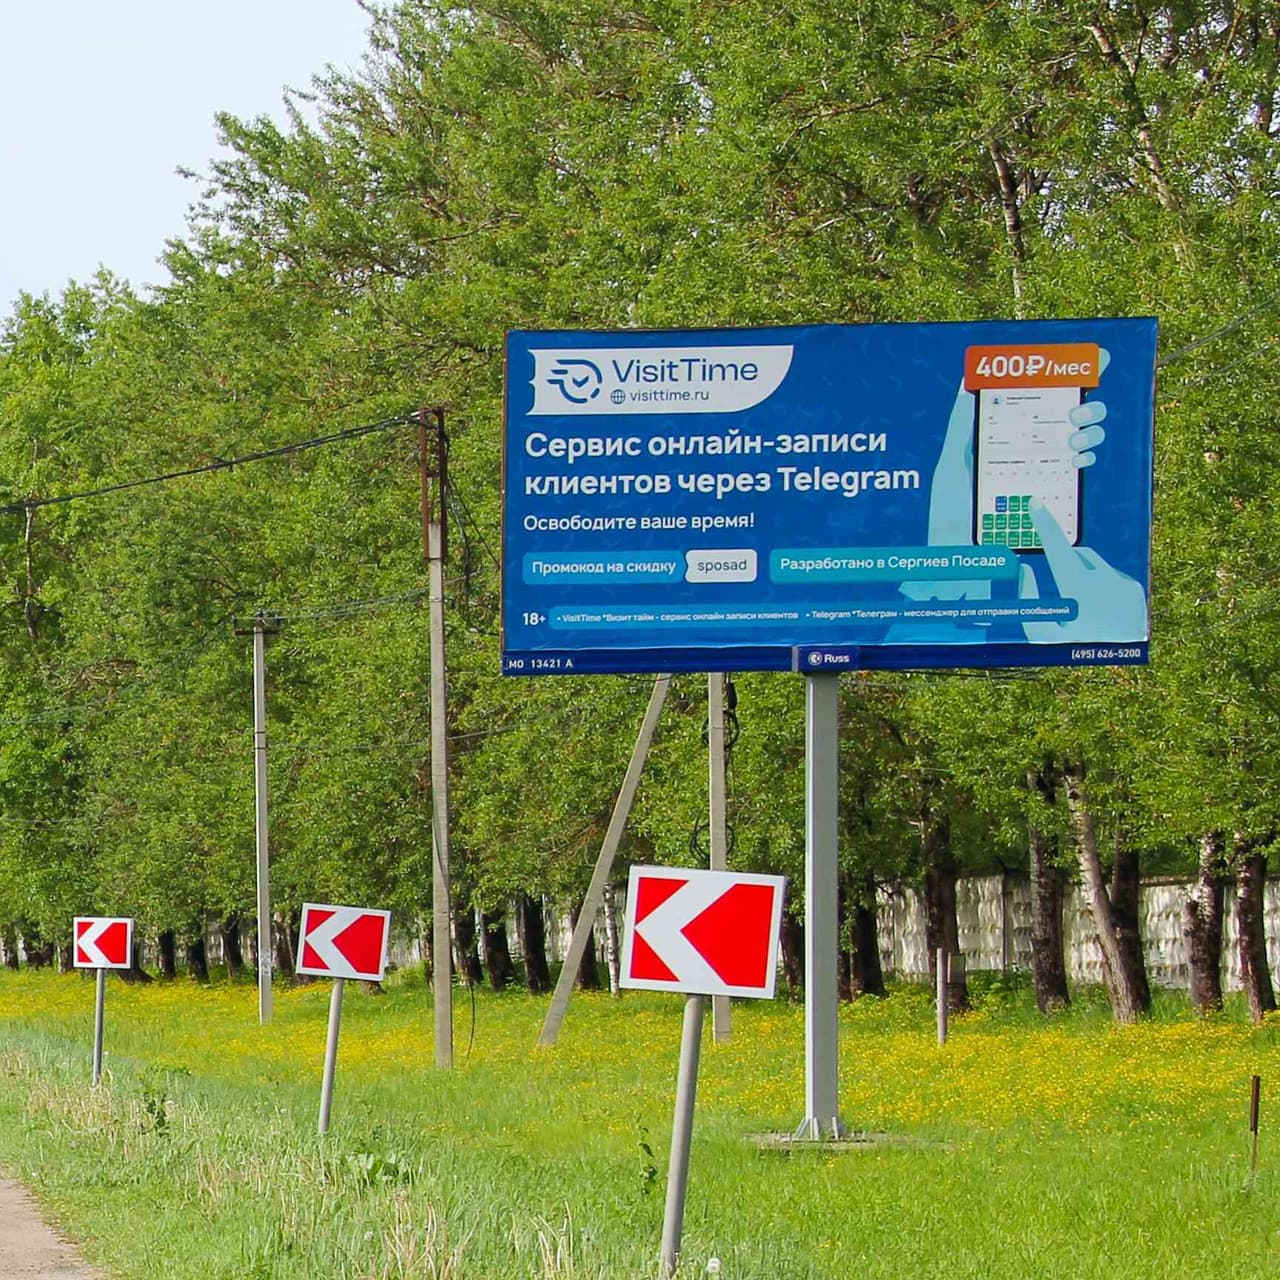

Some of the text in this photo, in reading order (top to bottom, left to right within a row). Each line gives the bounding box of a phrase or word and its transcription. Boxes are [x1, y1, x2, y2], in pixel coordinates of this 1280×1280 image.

[612, 358, 758, 383] VisitTime
[630, 390, 710, 402] visittime.ru
[525, 429, 887, 464] Сервис онлайн-записи
[525, 466, 920, 500] клиентов через Telegram
[523, 512, 755, 533] Освободите ваше время!
[532, 561, 676, 577] Промокод на скидку
[697, 559, 747, 573] sposad
[780, 555, 1006, 573] Разработано в Сергиев Посаде
[522, 612, 546, 626] 18+
[811, 611, 851, 621] Telegram
[824, 653, 850, 663] Russ
[1097, 648, 1141, 659] 626-5200
[531, 659, 561, 669] 13421
